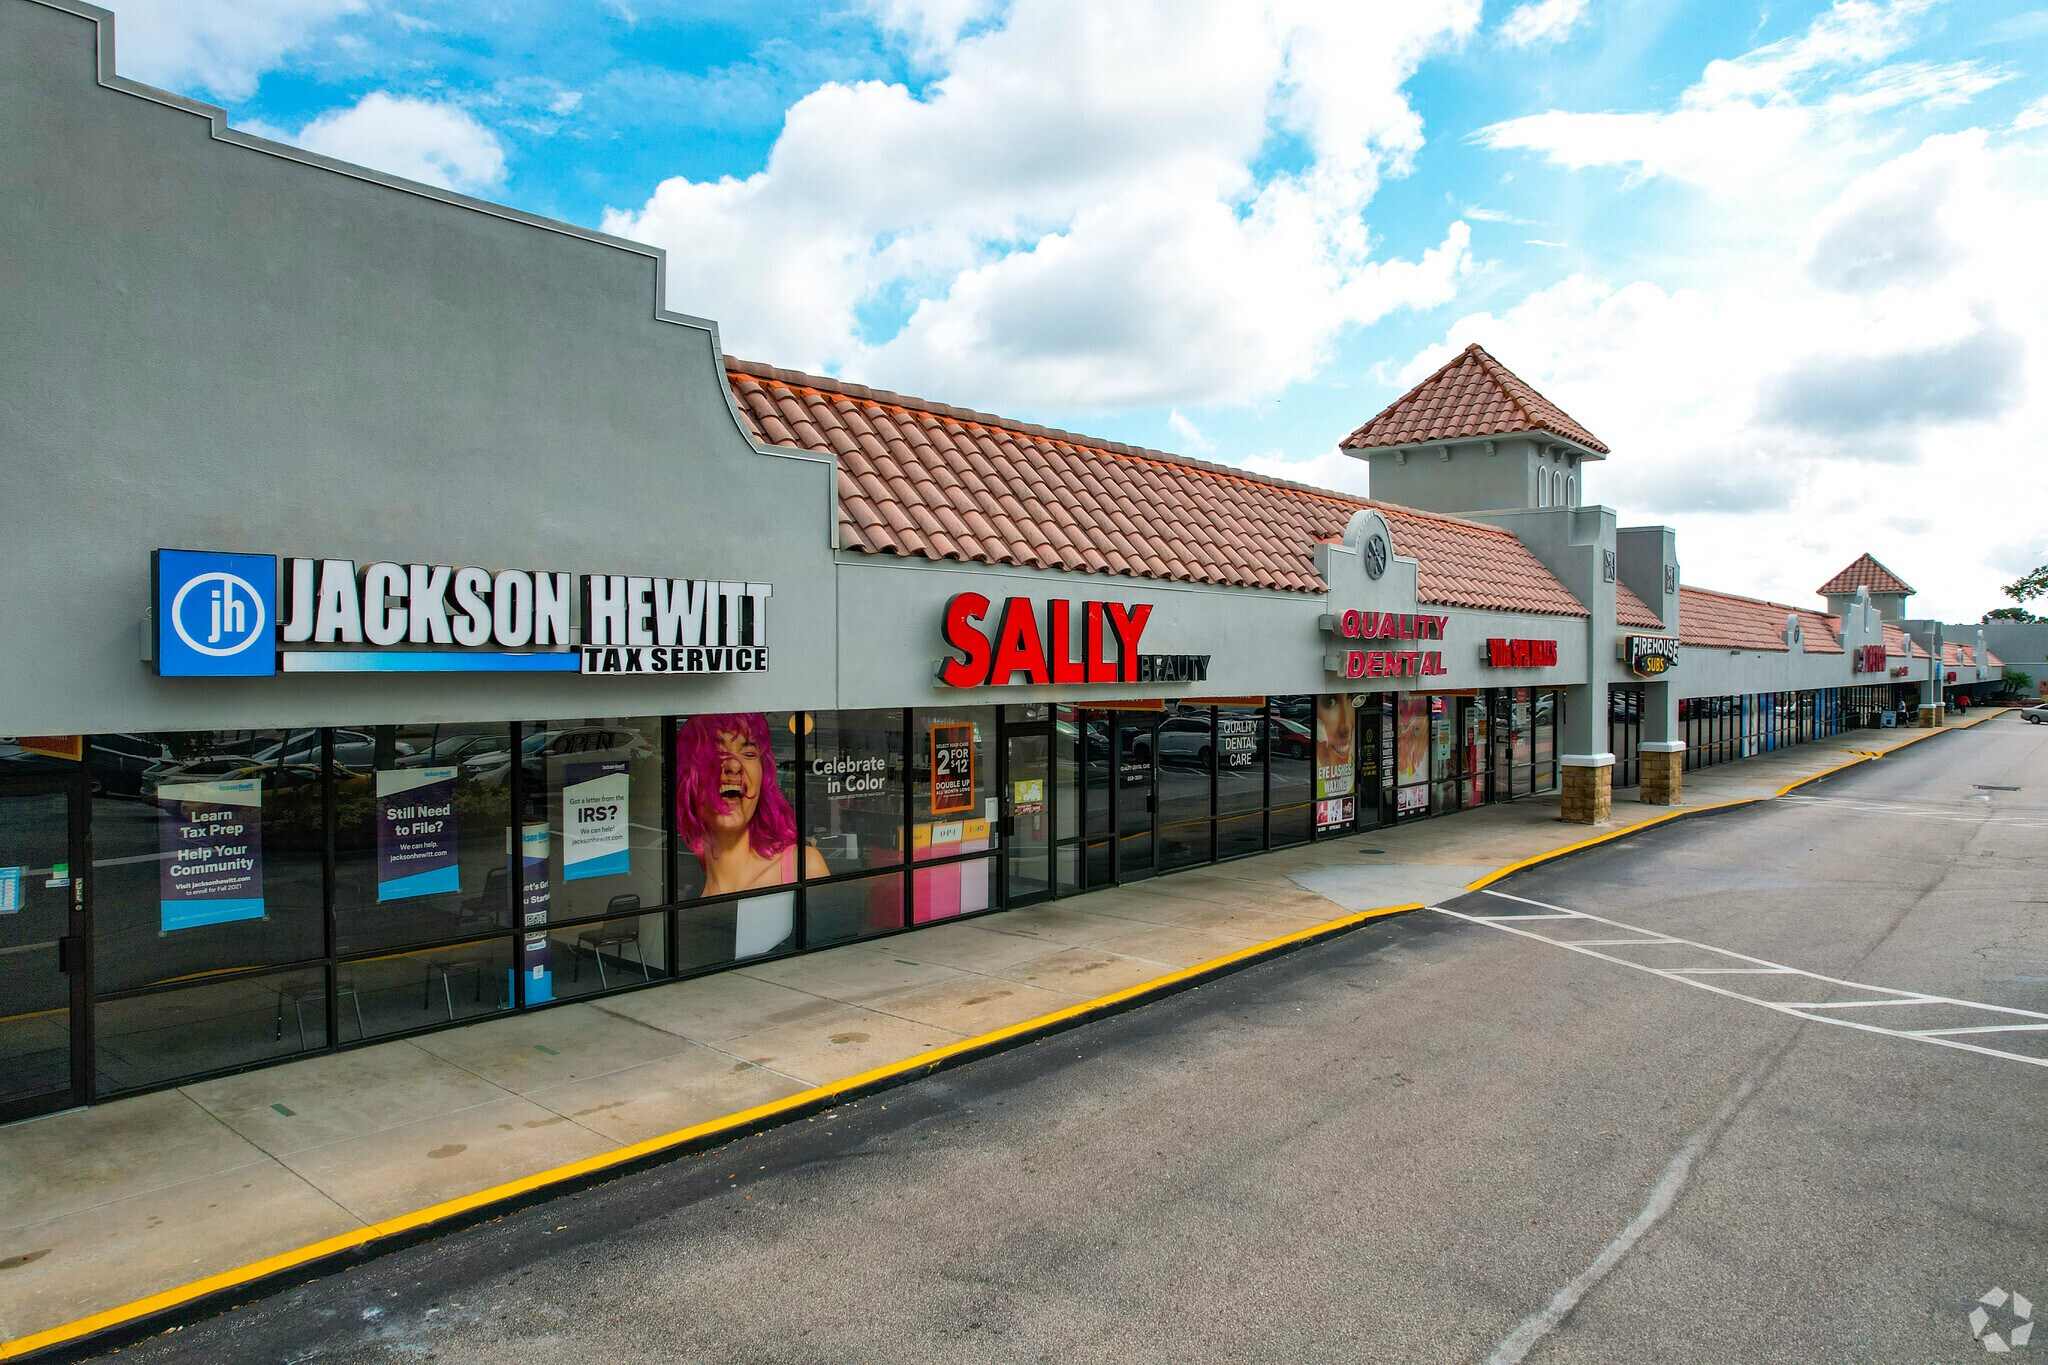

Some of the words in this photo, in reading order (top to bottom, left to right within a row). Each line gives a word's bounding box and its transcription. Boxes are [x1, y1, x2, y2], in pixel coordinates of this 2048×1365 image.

[284, 556, 572, 646] JACKSON
[582, 573, 774, 646] HEWITT
[1339, 609, 1449, 641] QUALITY
[938, 591, 1154, 689] SALLY
[1632, 637, 1679, 665] FIREHOUSE
[585, 646, 642, 673] TAX
[649, 646, 768, 673] SERVICE
[1346, 650, 1448, 679] DENTAL
[1647, 657, 1665, 672] SUBS
[1138, 654, 1212, 683] BEAUTY
[1223, 720, 1258, 734] QUALITY
[1225, 736, 1256, 750] DENTAL
[812, 755, 885, 775] Celebrate
[937, 749, 950, 775] 2
[950, 748, 969, 759] FOR
[1230, 753, 1252, 766] CARE
[1318, 766, 1331, 780] EYE
[1331, 763, 1353, 779] LASHES
[827, 777, 840, 793] in
[845, 773, 885, 792] Color
[936, 780, 961, 790] DOUBLE
[961, 779, 970, 788] UP
[1324, 779, 1349, 794] WAXING
[585, 796, 601, 804] letter
[601, 795, 615, 803] from
[191, 810, 233, 823] Learn
[386, 805, 415, 820] Still
[418, 803, 451, 818] Need
[578, 805, 618, 824] IRS?
[180, 826, 207, 838] Tax
[210, 824, 244, 837] Prep
[395, 824, 410, 836] to
[412, 820, 444, 835] File?
[424, 841, 439, 849] help.
[571, 834, 624, 846] jacksonhewitt.com
[177, 847, 213, 862] Help
[214, 845, 248, 857] Your
[390, 849, 448, 862] jacksonhewitt.com
[170, 858, 255, 877] Community
[175, 882, 192, 890] Visit
[192, 876, 251, 889] jacksonhewitt.com
[192, 887, 208, 895] enroll
